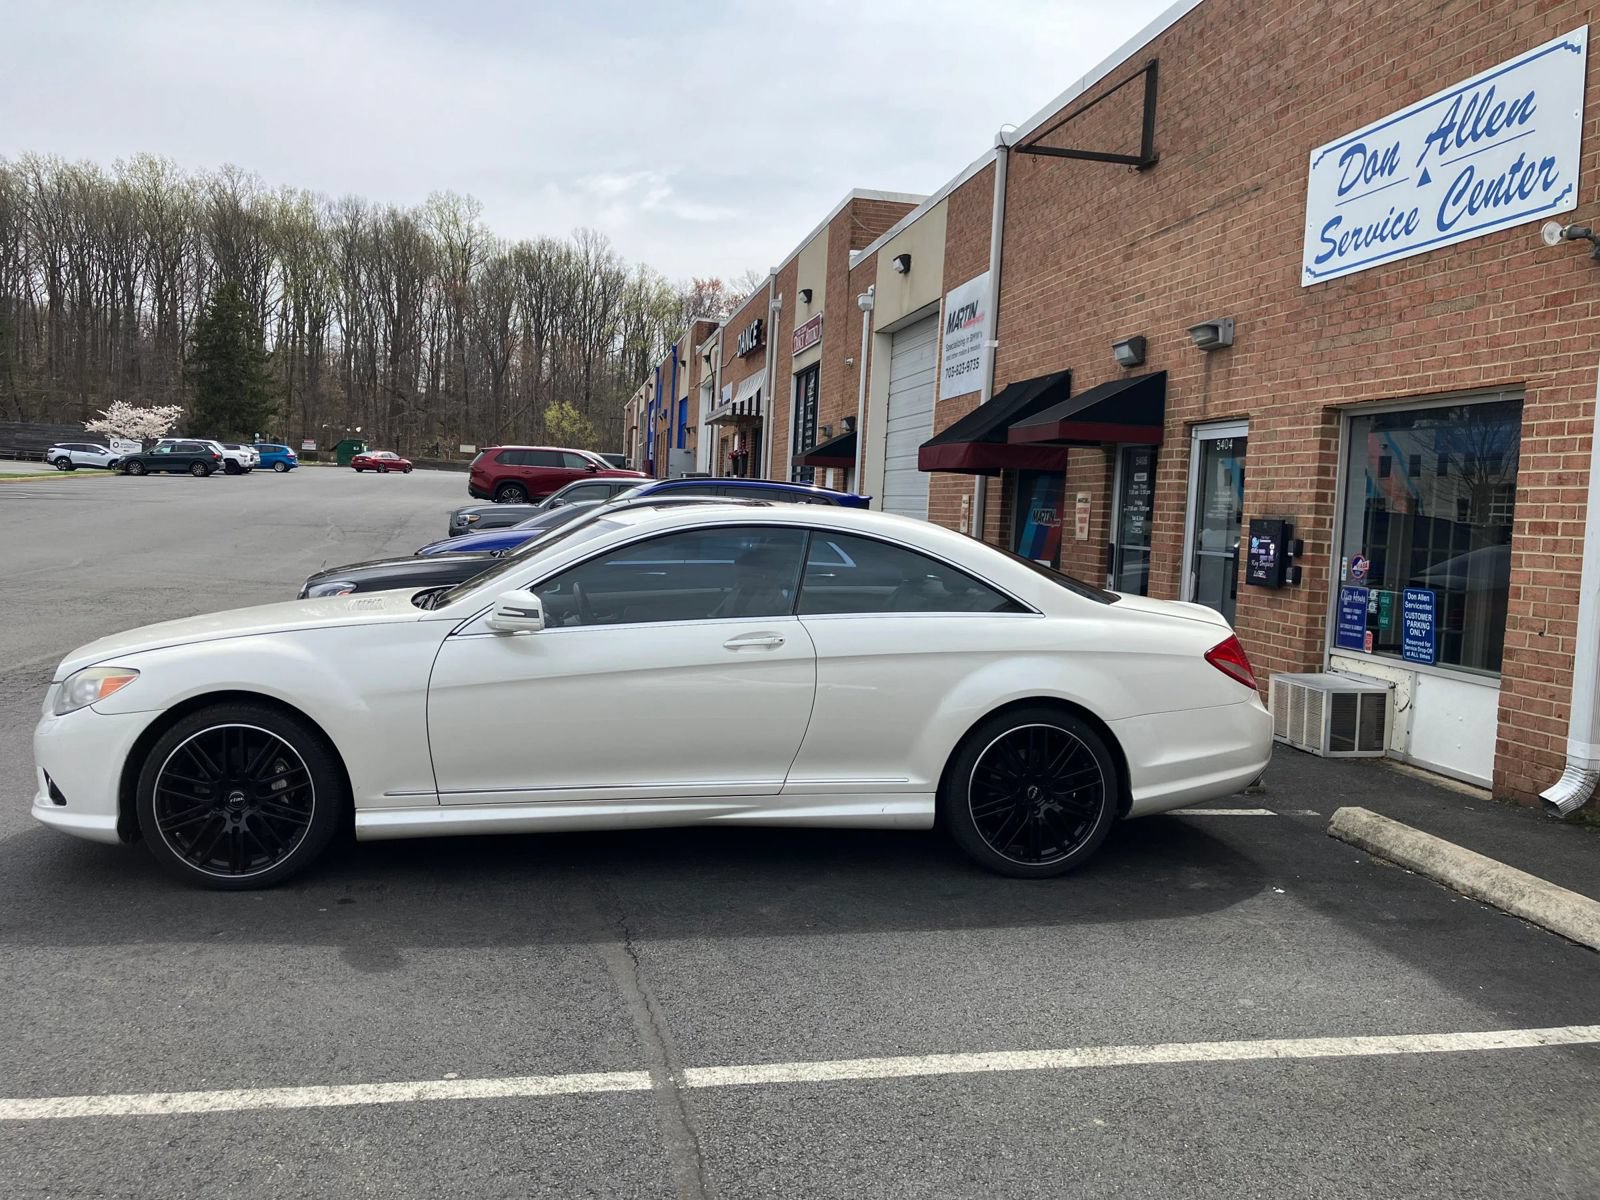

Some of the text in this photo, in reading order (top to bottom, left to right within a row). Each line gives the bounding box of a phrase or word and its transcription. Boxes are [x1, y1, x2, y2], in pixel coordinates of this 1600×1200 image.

[1338, 85, 1537, 197] Don Allen
[1314, 152, 1559, 264] Service Center
[946, 299, 979, 335] MARTIN
[737, 319, 759, 357] DANCE
[1216, 439, 1232, 450] 5404
[1032, 509, 1056, 524] MARTIN
[1407, 592, 1430, 601] Don Allen
[1405, 601, 1432, 610] Servicenter
[1405, 611, 1432, 621] CUSTOMER
[1407, 620, 1430, 630] PARKING
[1409, 628, 1426, 637] ONLY
